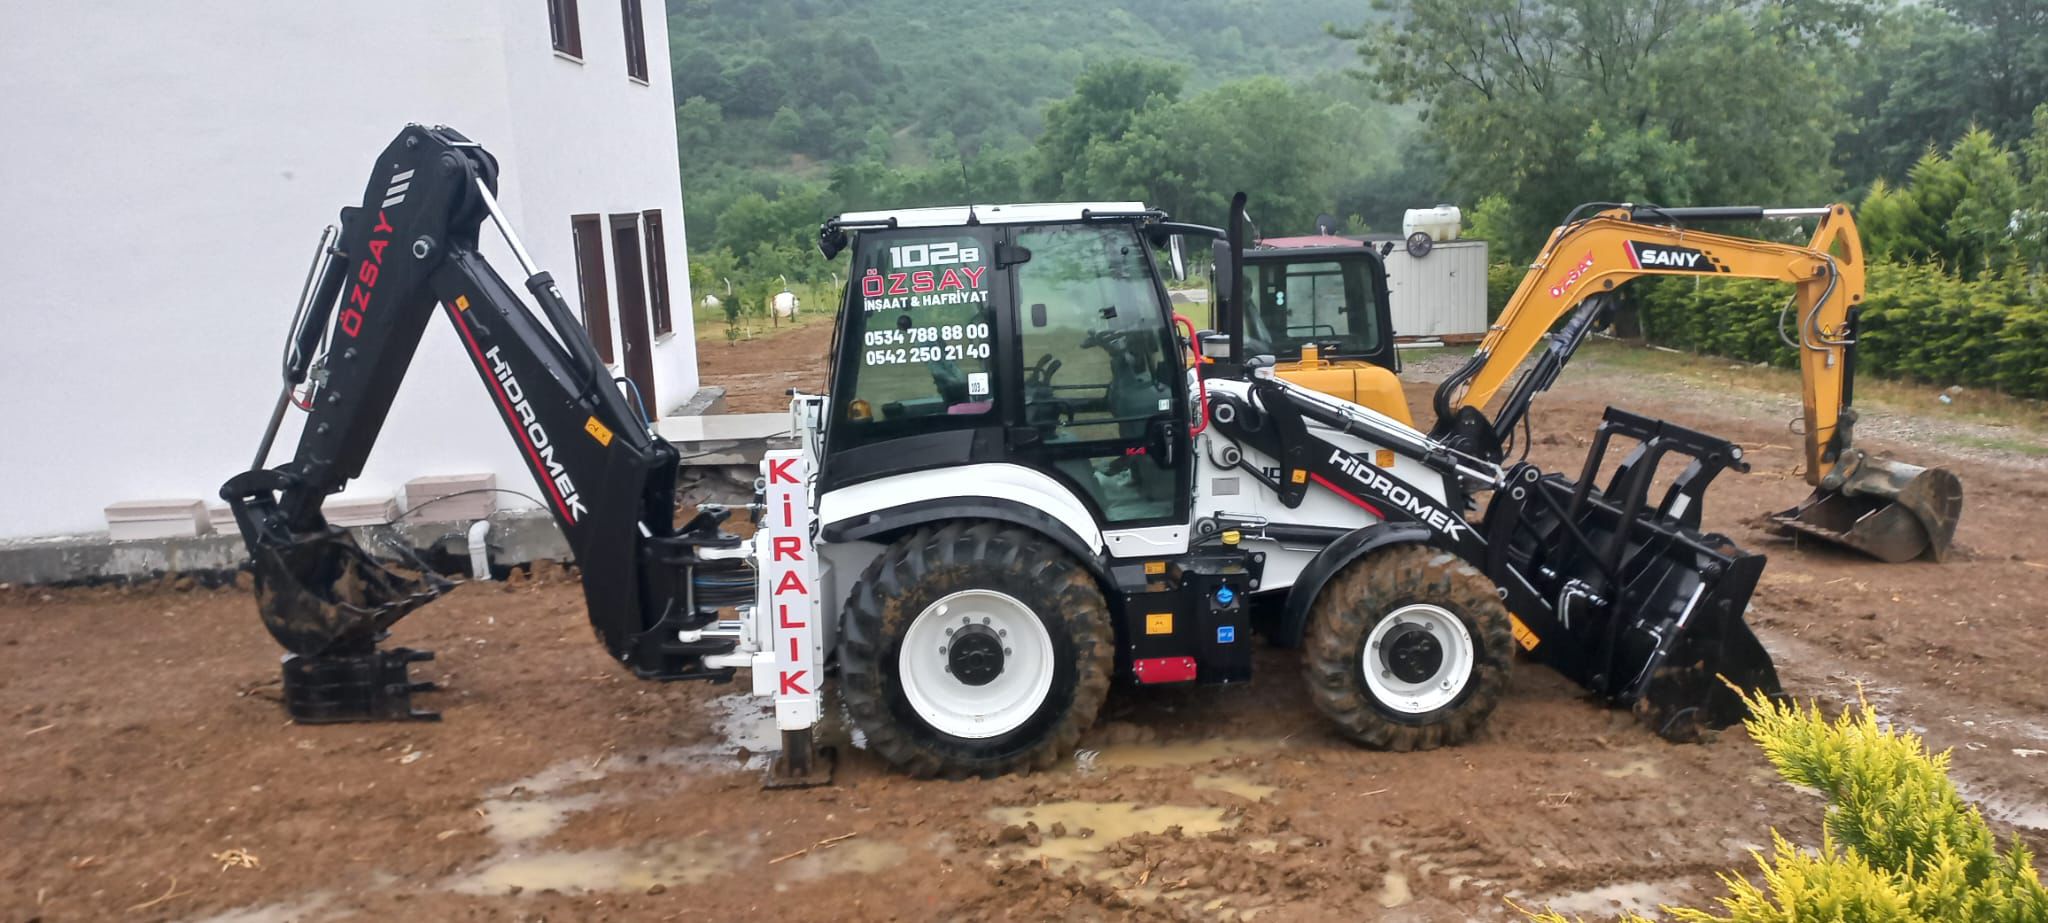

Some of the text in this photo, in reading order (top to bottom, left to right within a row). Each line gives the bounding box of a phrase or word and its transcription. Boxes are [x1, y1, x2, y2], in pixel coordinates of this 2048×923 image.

[1641, 249, 1701, 267] SANY
[339, 210, 393, 337] ÖZSAY
[862, 266, 986, 297] ÖZSAY
[864, 290, 988, 312] İNŞAAT & HAFRİYAT
[864, 323, 989, 346] 0534 788 88 00
[866, 343, 990, 365] 0542 250 21 40
